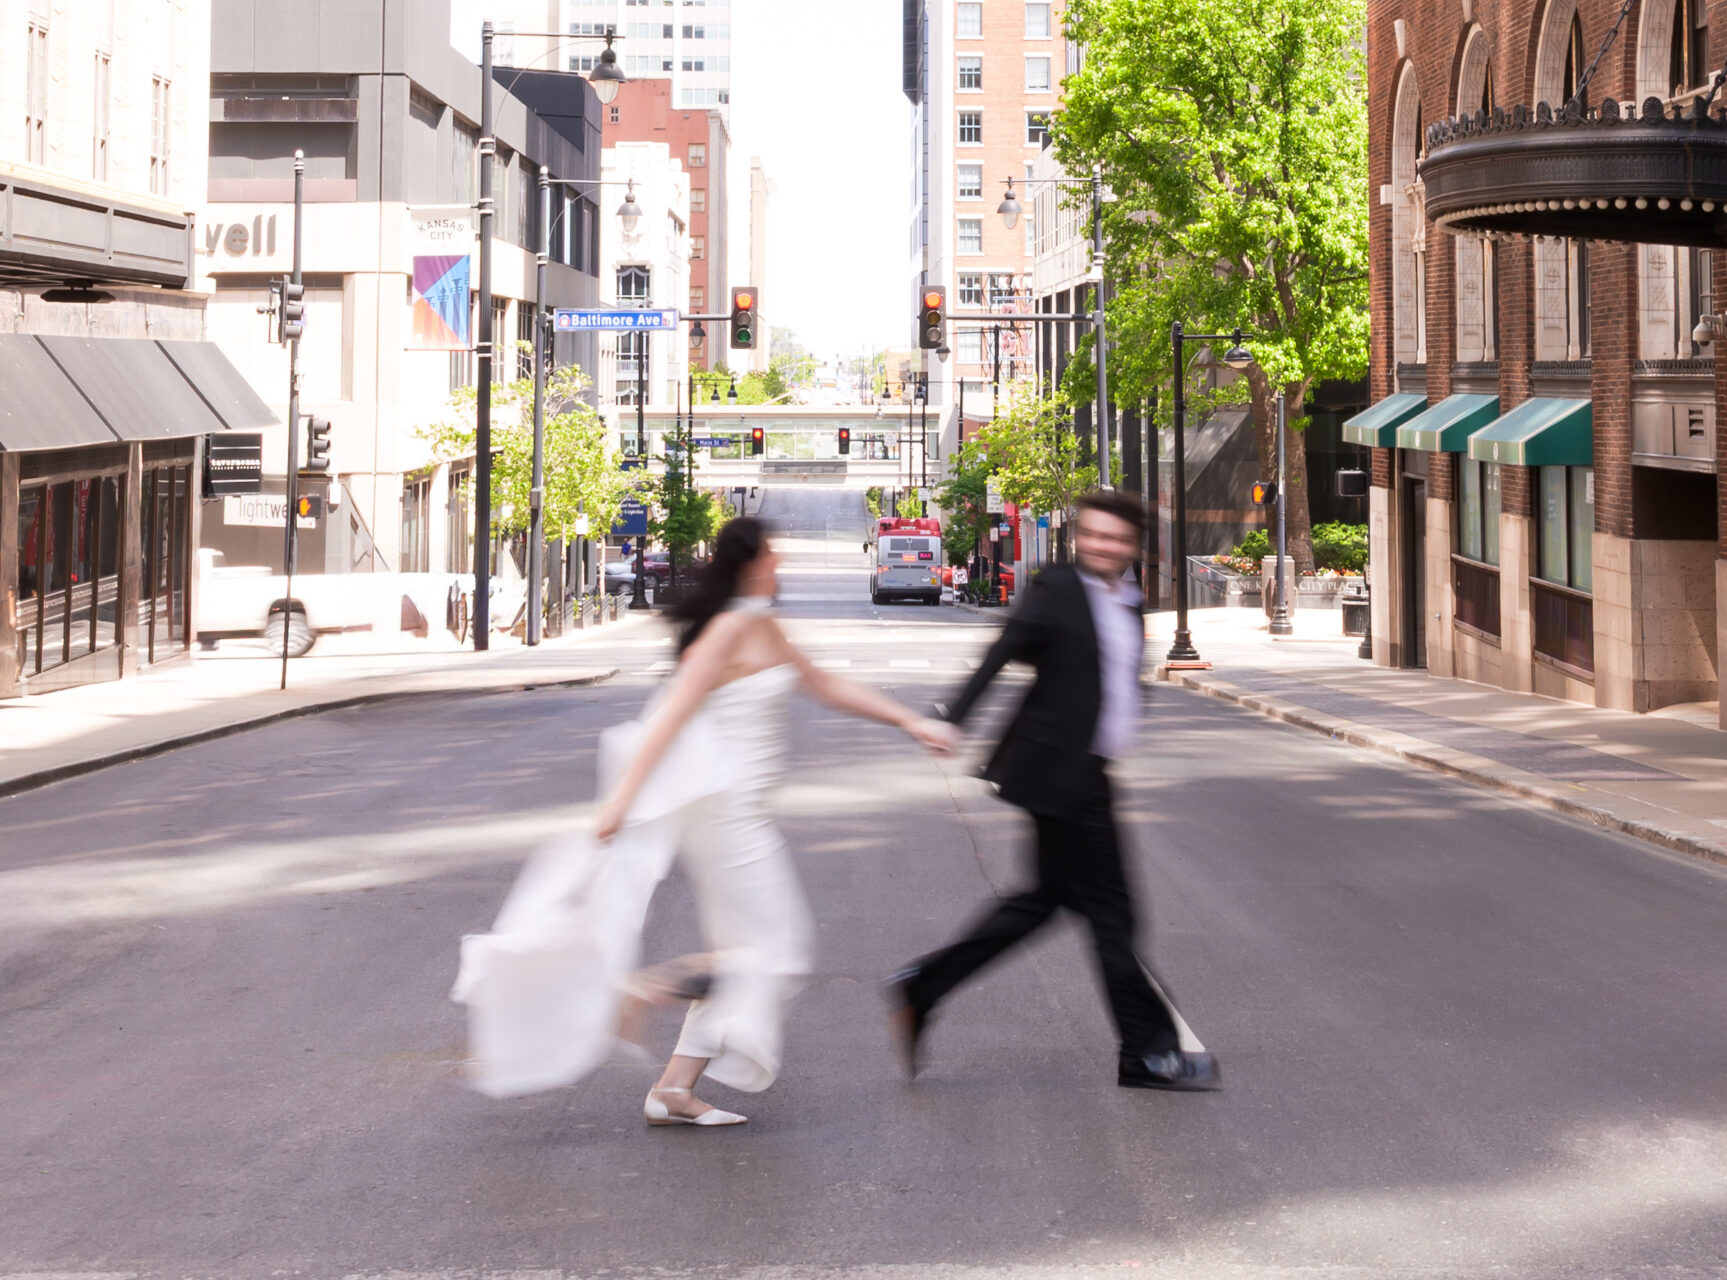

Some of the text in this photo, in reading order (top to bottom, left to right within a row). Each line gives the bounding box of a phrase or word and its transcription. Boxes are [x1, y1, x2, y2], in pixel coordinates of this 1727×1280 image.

[417, 219, 464, 232] KANSAS
[430, 231, 453, 240] CITY
[571, 314, 660, 326] Baltimore Ave
[239, 497, 287, 522] lightwe
[1230, 581, 1250, 590] ONE
[1299, 581, 1325, 591] CITY
